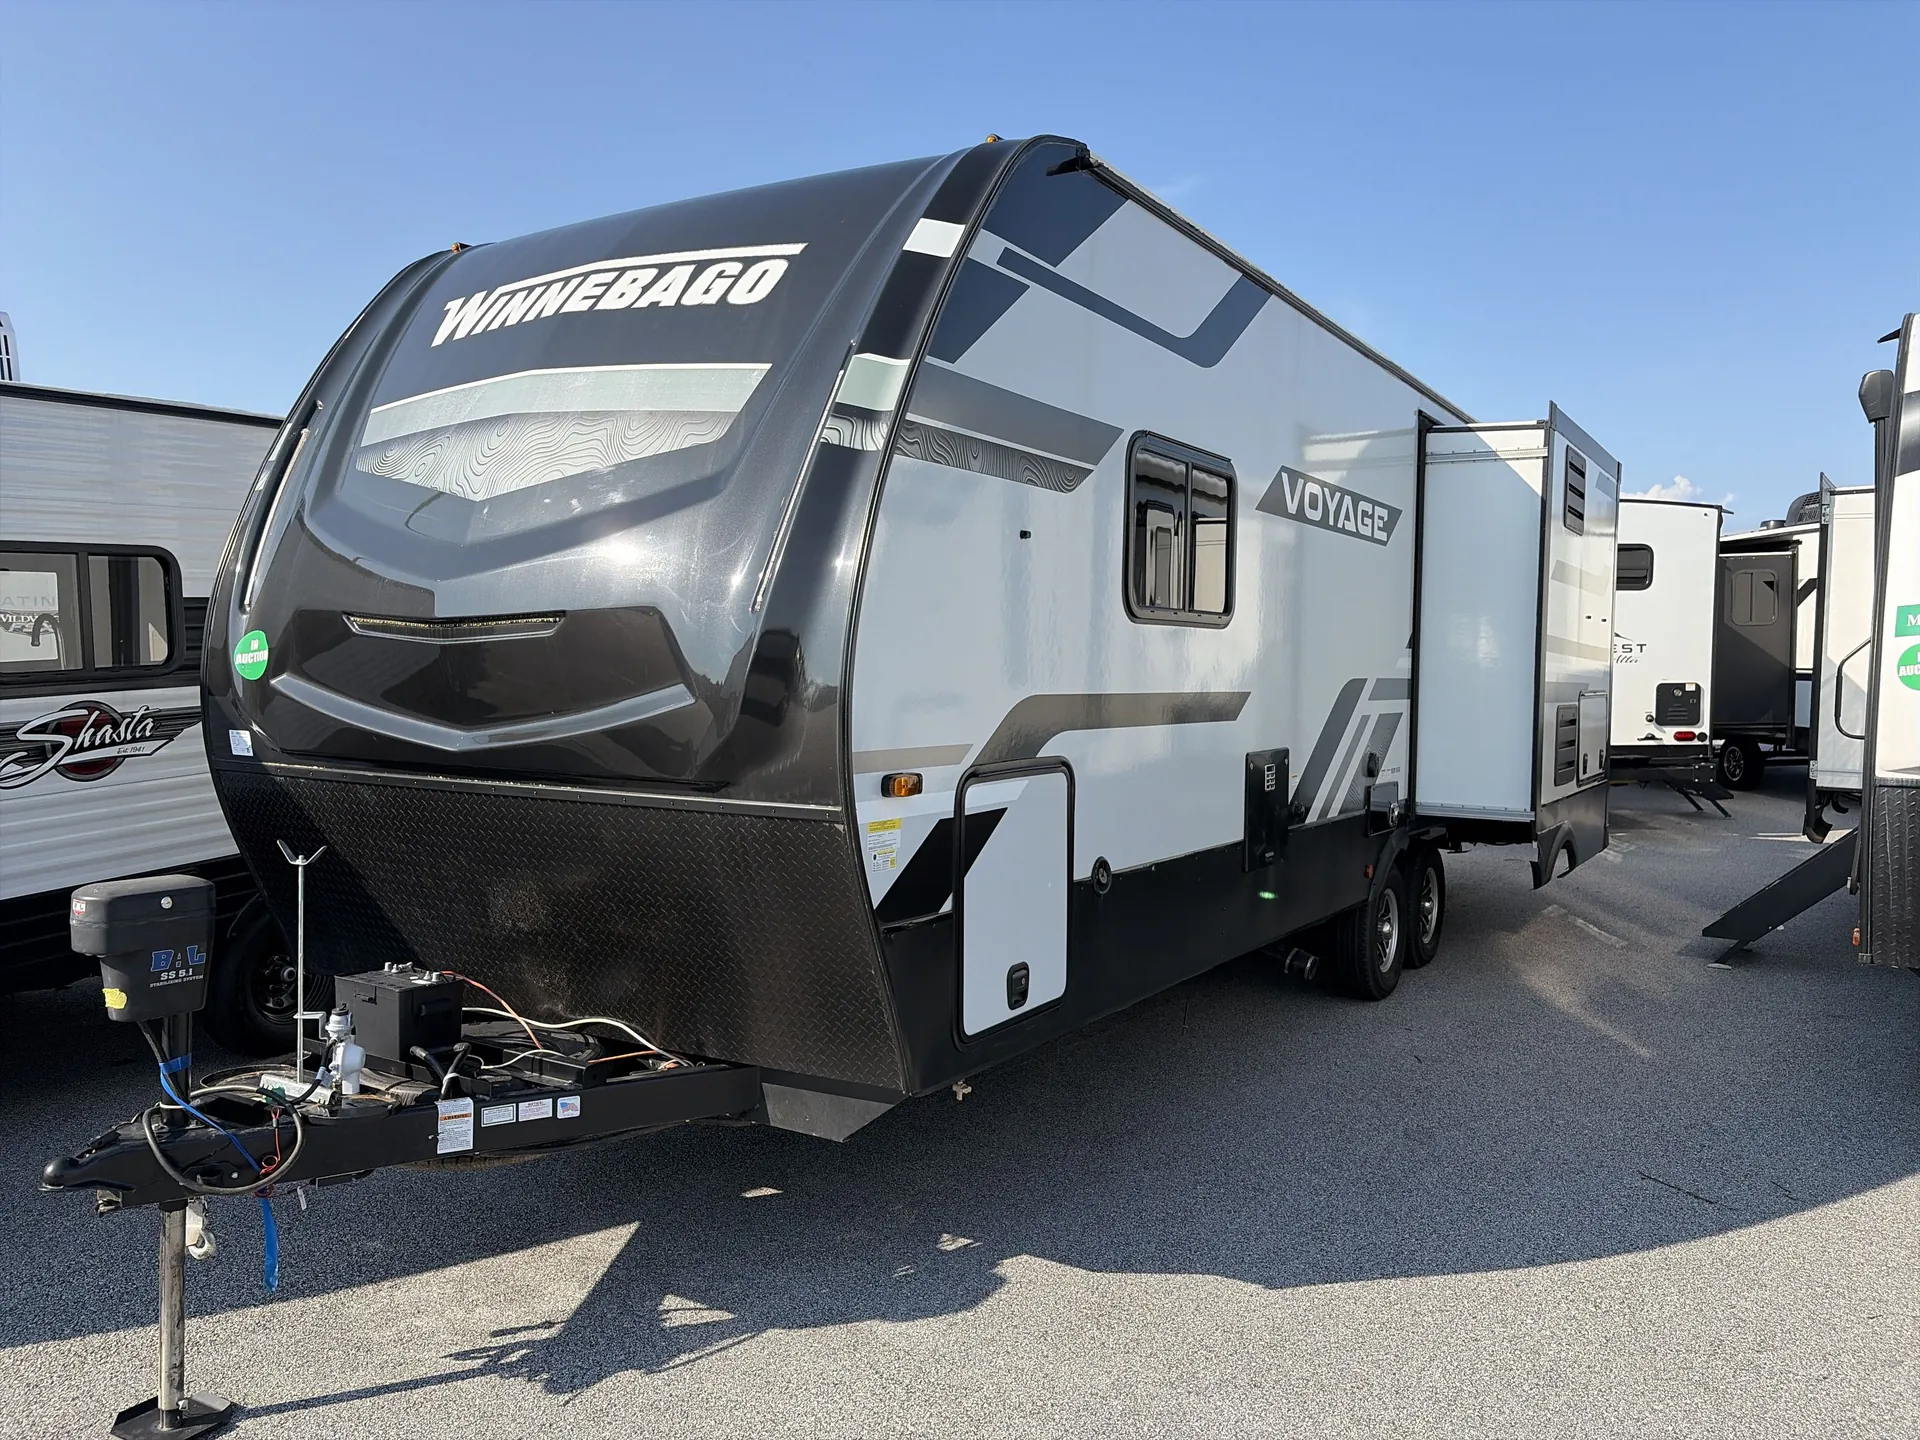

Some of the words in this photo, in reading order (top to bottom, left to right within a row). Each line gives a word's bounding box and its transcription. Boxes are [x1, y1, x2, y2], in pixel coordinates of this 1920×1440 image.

[430, 258, 790, 347] WINNEBAGO
[1281, 471, 1389, 542] VOYAGE
[250, 639, 259, 650] IN
[235, 649, 268, 664] AUCTION
[0, 704, 160, 790] Shasta
[160, 970, 177, 980] SS
[178, 968, 193, 978] 5.1
[183, 974, 204, 982] SYSTEM
